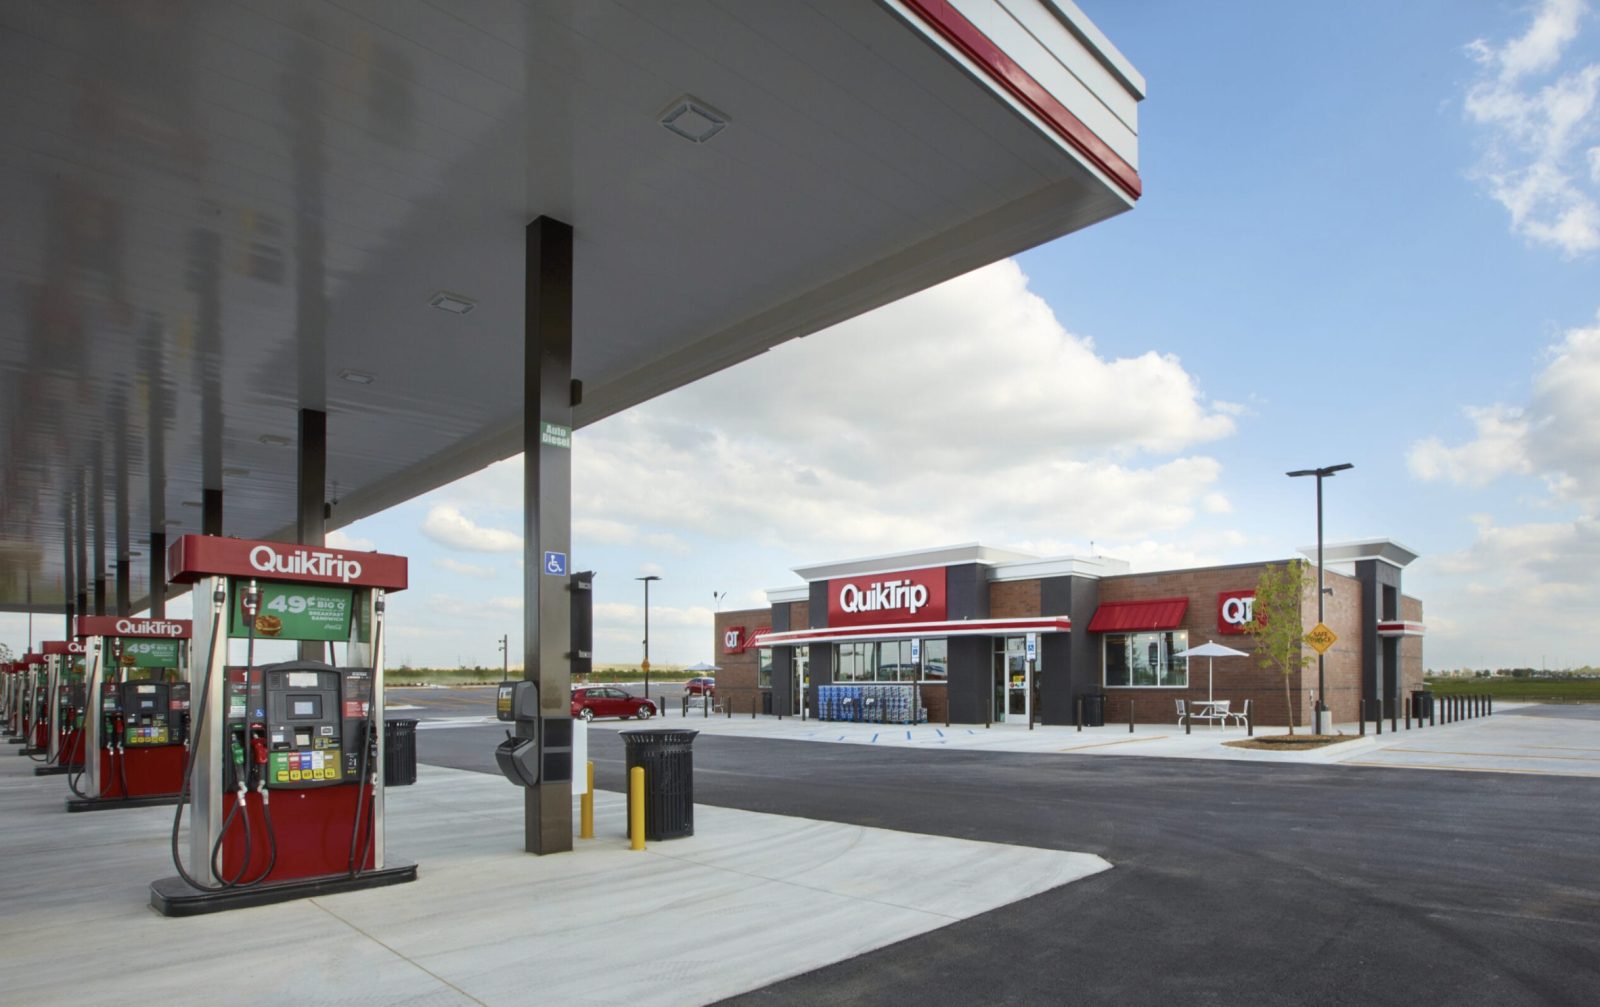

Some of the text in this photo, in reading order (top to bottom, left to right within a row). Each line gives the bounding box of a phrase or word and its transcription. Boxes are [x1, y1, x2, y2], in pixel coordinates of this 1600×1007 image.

[546, 424, 566, 437] Auto
[542, 432, 570, 448] Diesel
[250, 545, 362, 583] QuikTrip
[317, 601, 335, 609] BIG
[840, 579, 928, 614] QuikTrip
[1222, 597, 1256, 625] QT
[115, 619, 183, 637] QuikTrip
[725, 630, 739, 648] QT
